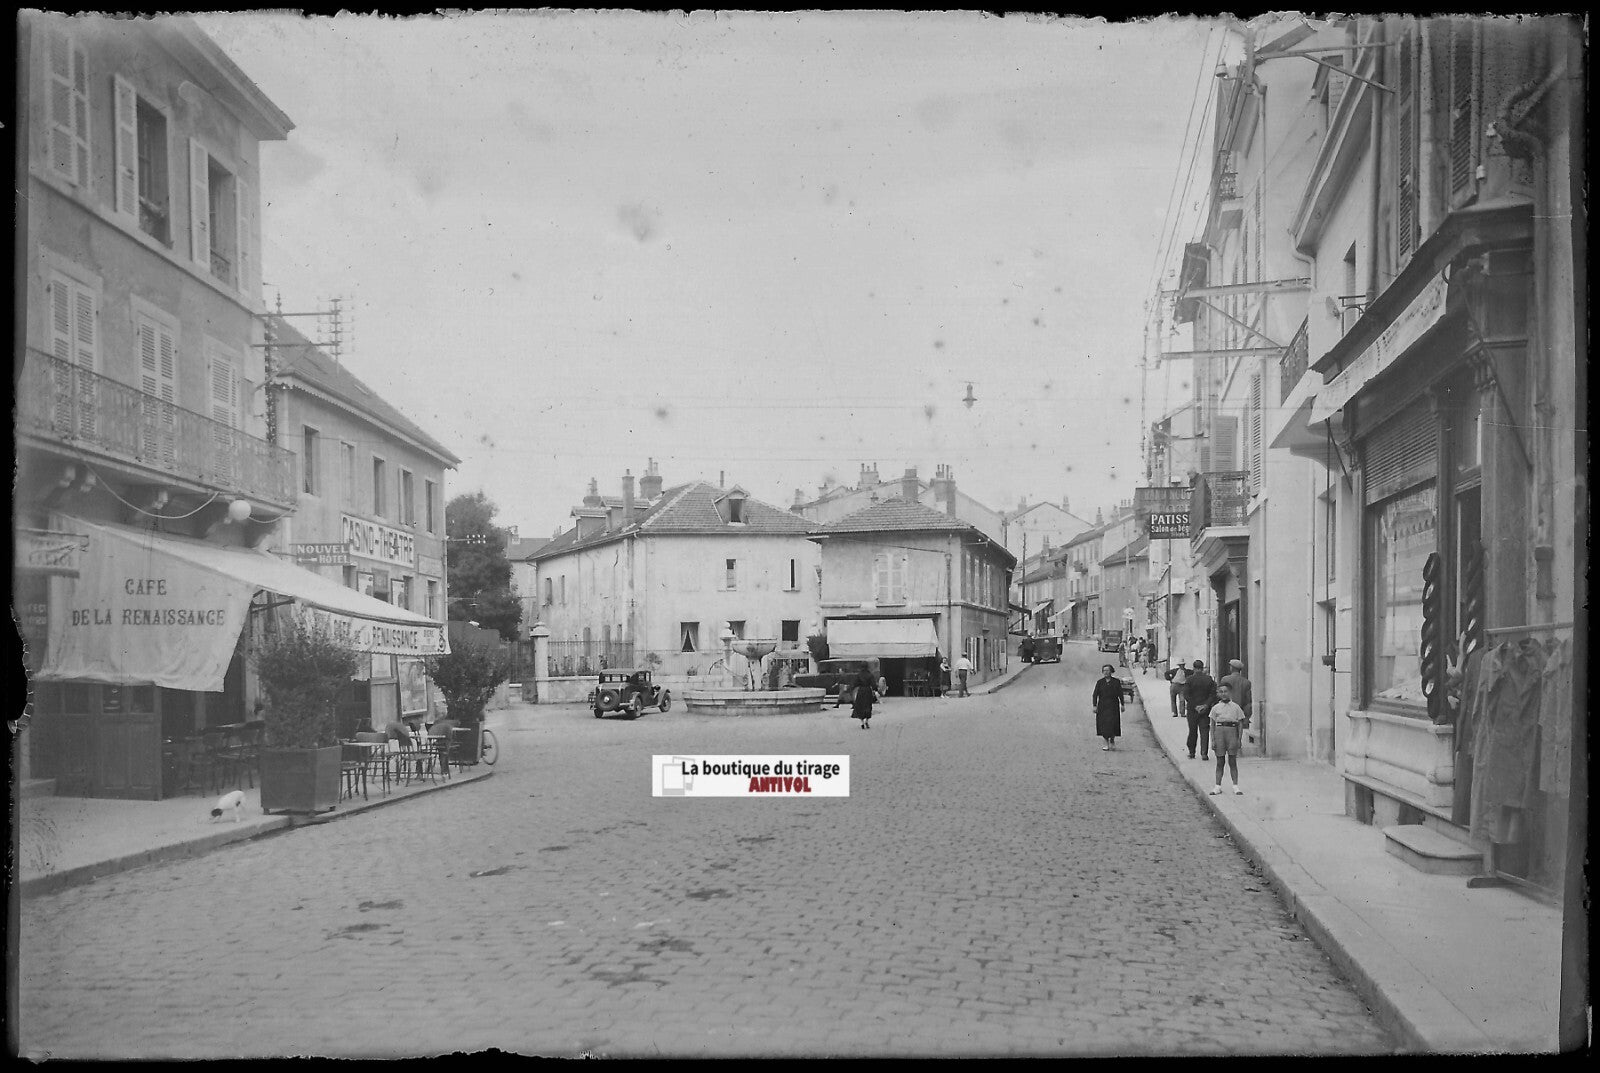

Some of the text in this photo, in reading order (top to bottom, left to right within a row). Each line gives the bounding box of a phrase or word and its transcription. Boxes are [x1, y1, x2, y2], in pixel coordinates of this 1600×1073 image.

[1151, 524, 1169, 533] Salon
[297, 545, 348, 554] NOUVEL
[124, 578, 167, 596] CAFE
[72, 609, 225, 626] DE LA RENAISSANCE
[372, 626, 418, 649] RENAISSANCE
